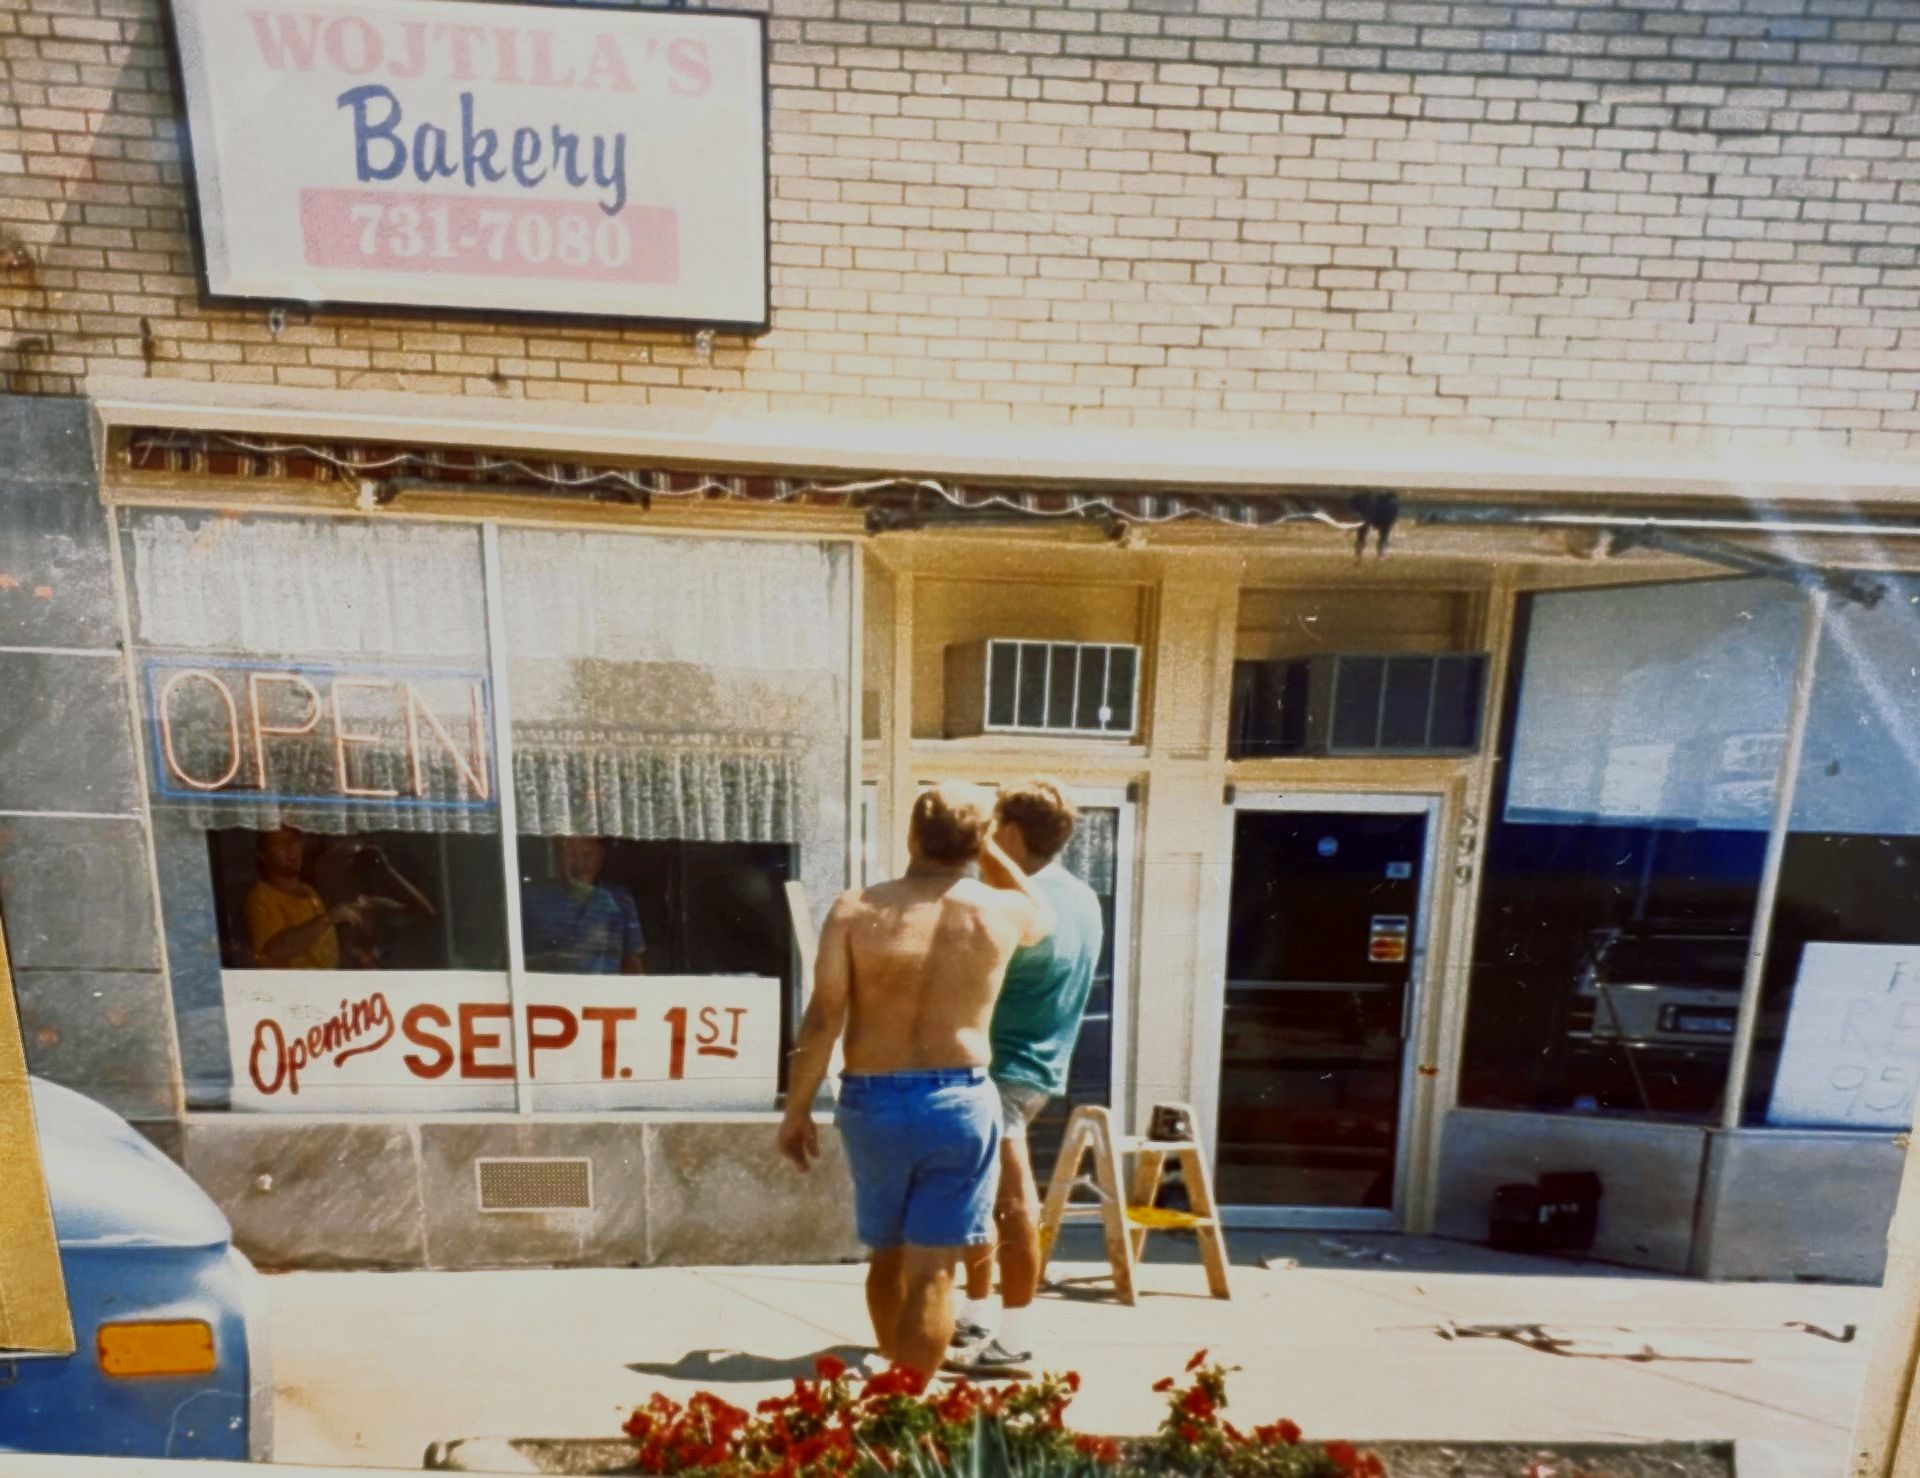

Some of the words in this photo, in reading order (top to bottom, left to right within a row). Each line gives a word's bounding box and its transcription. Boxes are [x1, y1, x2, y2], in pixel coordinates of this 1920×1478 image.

[245, 10, 714, 97] WOJTILA'S
[337, 83, 627, 216] Bakery
[350, 203, 630, 269] 731-7080
[159, 668, 489, 799] OPEN
[249, 991, 395, 1095] Opening
[401, 1002, 638, 1080] SEPT.
